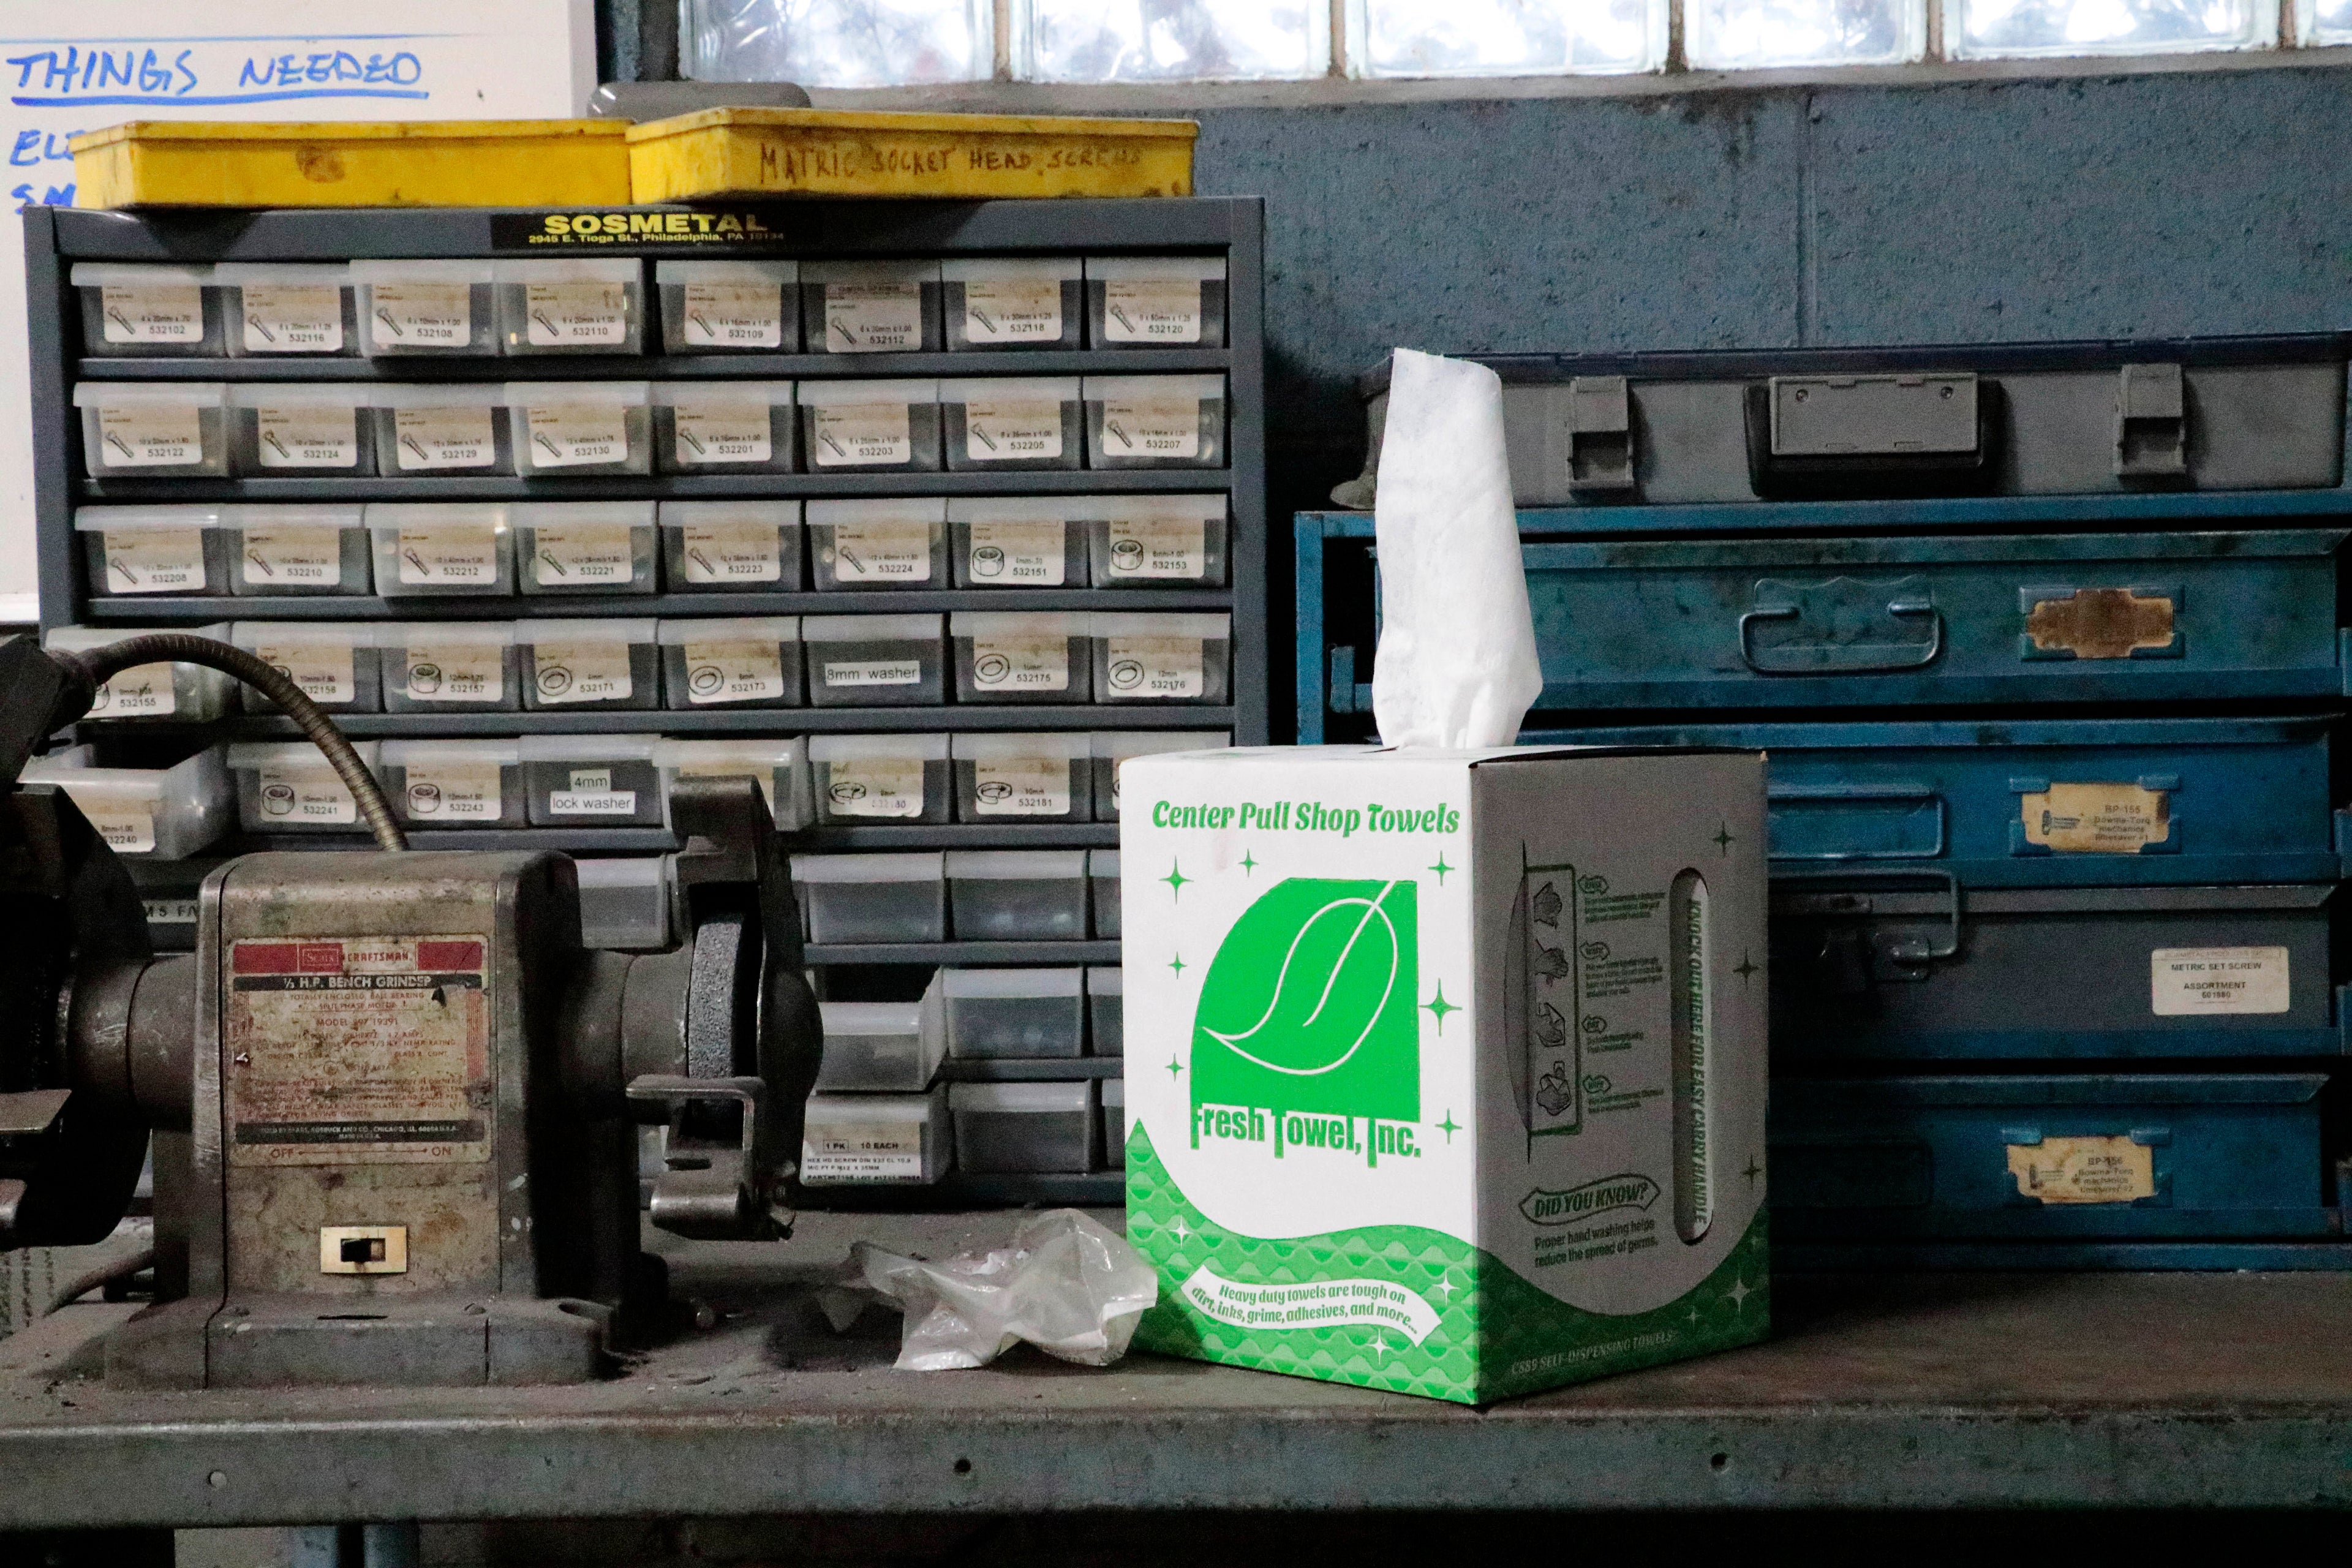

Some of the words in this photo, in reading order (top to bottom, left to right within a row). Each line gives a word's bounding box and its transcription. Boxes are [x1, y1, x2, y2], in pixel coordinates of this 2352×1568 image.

[7, 47, 197, 94] THINGS
[238, 50, 421, 87] NEEDED
[870, 146, 956, 175] SOCKET
[968, 149, 1032, 170] HEAD
[544, 213, 768, 235] SOSMETAL
[562, 234, 575, 243] E.
[578, 234, 614, 244] Tioga
[727, 232, 744, 241] PA
[149, 323, 186, 334] 532102
[417, 328, 453, 338] 532108
[572, 326, 608, 336] 532110
[1010, 323, 1045, 333] 532118
[1148, 324, 1183, 334] 532120
[289, 333, 325, 343] 532116
[728, 329, 764, 339] 532109
[869, 336, 904, 345] 532112
[718, 444, 753, 454] 532201
[1010, 440, 1045, 450] 532205
[1146, 439, 1181, 449] 532207
[148, 447, 184, 458] 532122
[303, 449, 339, 459] 532124
[442, 449, 477, 459] 532129
[575, 445, 610, 456] 532130
[859, 447, 894, 456] 532203
[443, 565, 479, 576] 532212
[579, 565, 614, 576] 532221
[727, 563, 763, 574] 532223
[878, 564, 913, 573] 532224
[1152, 560, 1187, 570] 532153
[287, 567, 323, 577] 532210
[1012, 567, 1047, 576] 532151
[151, 573, 187, 583] 532208
[826, 669, 861, 682] 8mm
[868, 667, 918, 680] washer
[1016, 673, 1051, 682] 532175
[450, 684, 484, 693] 532157
[579, 681, 614, 693] 532171
[731, 681, 766, 693] 532173
[119, 696, 157, 707] 532155
[574, 774, 608, 789] 4mm
[449, 803, 483, 812] 532243
[552, 796, 578, 810] lock
[582, 796, 631, 810] washer
[1019, 797, 1052, 807] 532181
[303, 804, 337, 815] 532241
[1152, 800, 1235, 829] Center
[1239, 801, 1291, 830] Pull
[1295, 801, 1361, 838] Shop
[1367, 802, 1460, 834] Towels
[1689, 899, 1702, 956] KNOCK
[2171, 963, 2206, 971] METRIC
[2208, 962, 2226, 971] SET
[2228, 962, 2262, 971] SCREW
[1688, 957, 1703, 990] OUT
[329, 976, 372, 987] BENCH
[2184, 981, 2246, 990] ASSORTMENT
[391, 991, 425, 1000] BEARING
[1689, 990, 1704, 1033] HERE
[316, 1018, 348, 1027] MODEL
[1690, 1034, 1705, 1066] FOR
[1691, 1068, 1705, 1107] EASY
[1190, 1103, 1266, 1150] Fresh
[1274, 1111, 1362, 1159] Towel,
[1367, 1117, 1422, 1168] Inc.
[1692, 1109, 1706, 1163] CARRY
[271, 1148, 295, 1159] OFF
[431, 1146, 452, 1156] ON
[1534, 1197, 1562, 1218] DID
[1564, 1191, 1594, 1213] YOU
[1596, 1182, 1648, 1208] KNOW?
[1534, 1234, 1566, 1251] Proper
[1567, 1227, 1591, 1245] hand
[1591, 1222, 1629, 1240] washing
[1631, 1218, 1655, 1233] helps
[1534, 1251, 1567, 1268] reduce
[1569, 1248, 1583, 1261] the
[1585, 1243, 1615, 1260] spread
[1617, 1239, 1626, 1252] of
[1218, 1284, 1256, 1305] Heavy
[1258, 1284, 1286, 1305] duty
[1287, 1285, 1326, 1302] towels
[1328, 1286, 1349, 1299] are
[1351, 1283, 1387, 1302] tough
[1389, 1289, 1406, 1305] on
[1191, 1286, 1216, 1314] dirt,
[1216, 1301, 1245, 1322] inks,
[1246, 1308, 1285, 1324] grime,
[1286, 1304, 1349, 1322] adhesives,
[1349, 1302, 1374, 1316] and
[1376, 1306, 1419, 1335] more...
[1634, 1329, 1673, 1350] TOWELS
